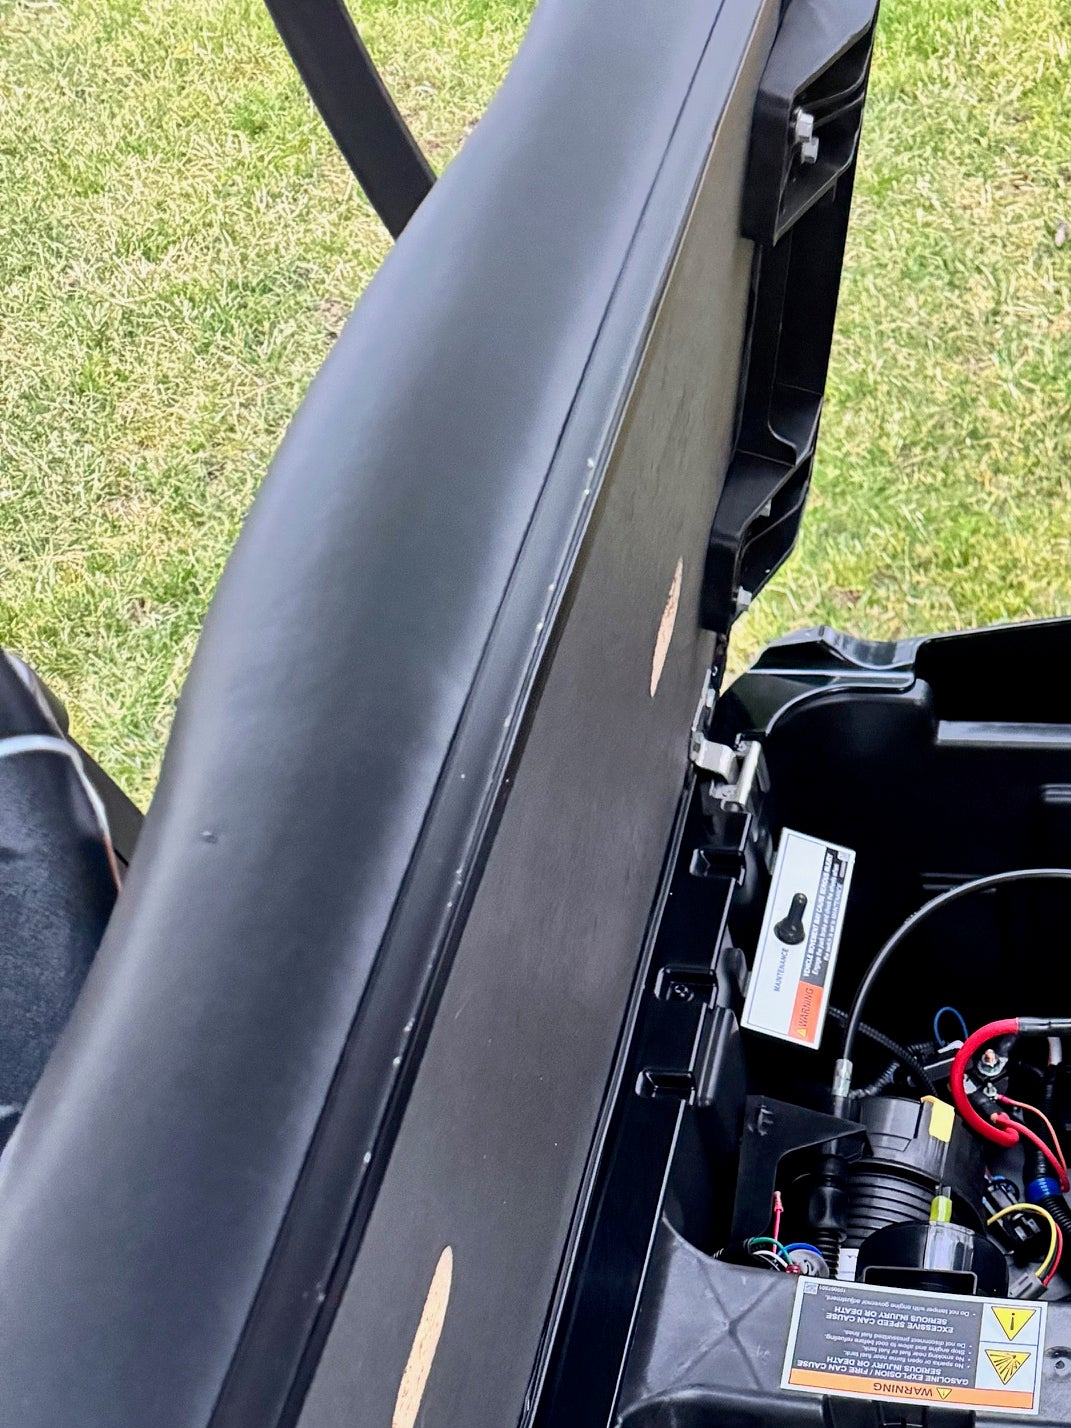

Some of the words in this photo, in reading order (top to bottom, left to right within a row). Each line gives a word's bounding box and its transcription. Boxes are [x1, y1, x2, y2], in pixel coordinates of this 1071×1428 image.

[773, 947, 788, 992] MAINTENANCE
[798, 986, 813, 1028] WARNING
[833, 1305, 862, 1315] DEATH
[890, 1301, 911, 1309] engine
[925, 1306, 948, 1314] tamper
[824, 1312, 855, 1322] CAUSE
[863, 1309, 877, 1317] OR
[878, 1311, 908, 1320] INJURY
[856, 1316, 875, 1324] CAN
[876, 1318, 905, 1328] SPEED
[909, 1315, 947, 1325] SERIOUS
[906, 1322, 953, 1333] EXCESSIVE
[928, 1345, 949, 1353] engine
[825, 1355, 855, 1365] DEATH
[907, 1355, 923, 1363] open
[927, 1351, 954, 1360] smoking
[796, 1359, 827, 1369] CAUSE
[828, 1363, 847, 1372] CAN
[856, 1359, 870, 1367] OR
[871, 1361, 902, 1371] INJURY
[932, 1358, 953, 1367] sparks
[848, 1366, 868, 1374] FIRE
[874, 1369, 923, 1380] EXPLOSION
[903, 1364, 941, 1375] SERIOUS
[924, 1374, 968, 1385] GASOLINE
[872, 1382, 933, 1396] WARNING
